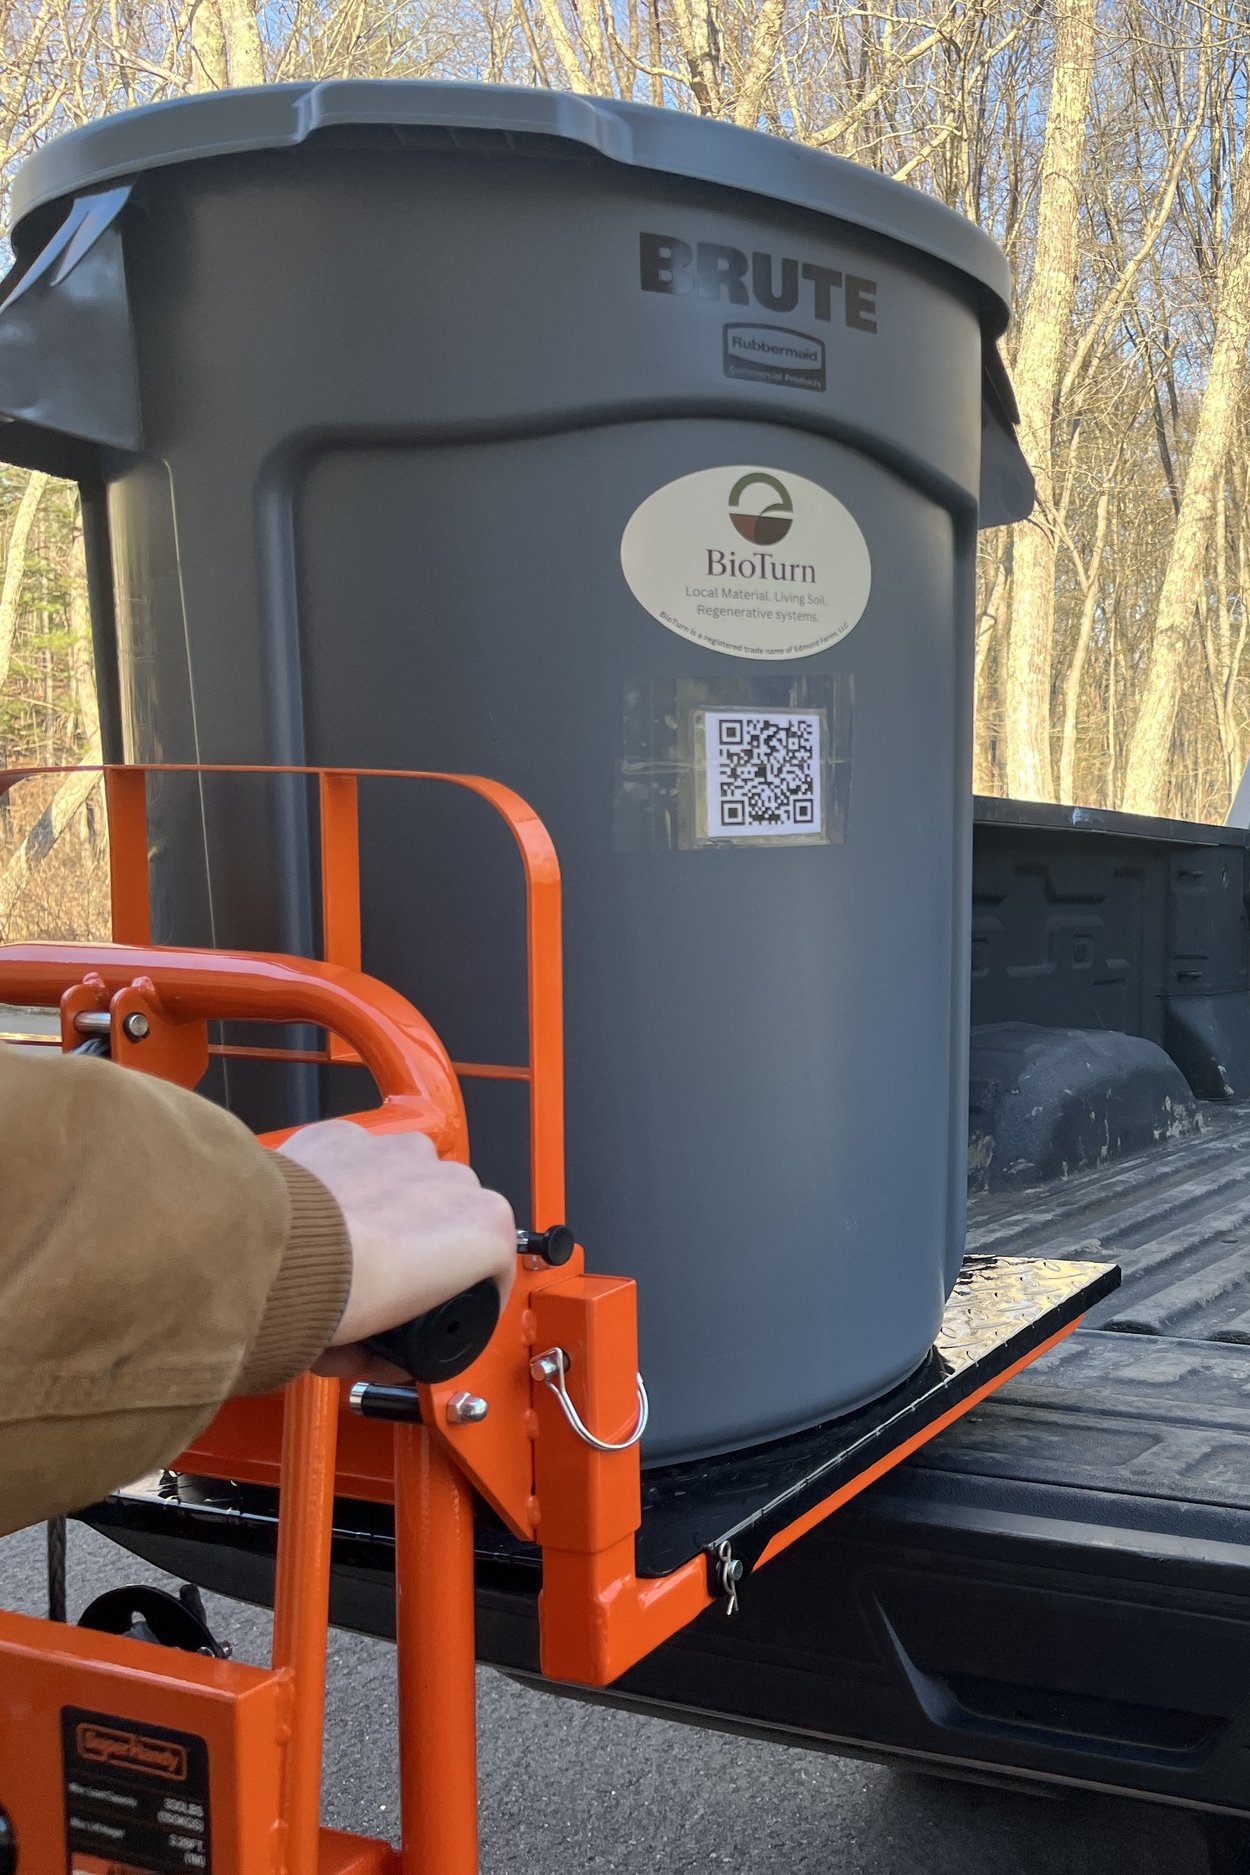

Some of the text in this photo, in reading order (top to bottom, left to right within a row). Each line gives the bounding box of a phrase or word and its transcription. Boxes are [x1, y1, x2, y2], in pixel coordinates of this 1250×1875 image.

[640, 232, 877, 334] BRUTE
[731, 335, 818, 362] Rubbermaid
[706, 548, 817, 584] BioTurn
[685, 586, 827, 607] Local Material. Living Soil.
[697, 604, 820, 623] Regenerative systems.
[658, 611, 690, 633] BioTurn
[689, 628, 697, 636] is
[704, 635, 743, 652] registered
[744, 647, 764, 655] trade
[785, 646, 793, 654] of
